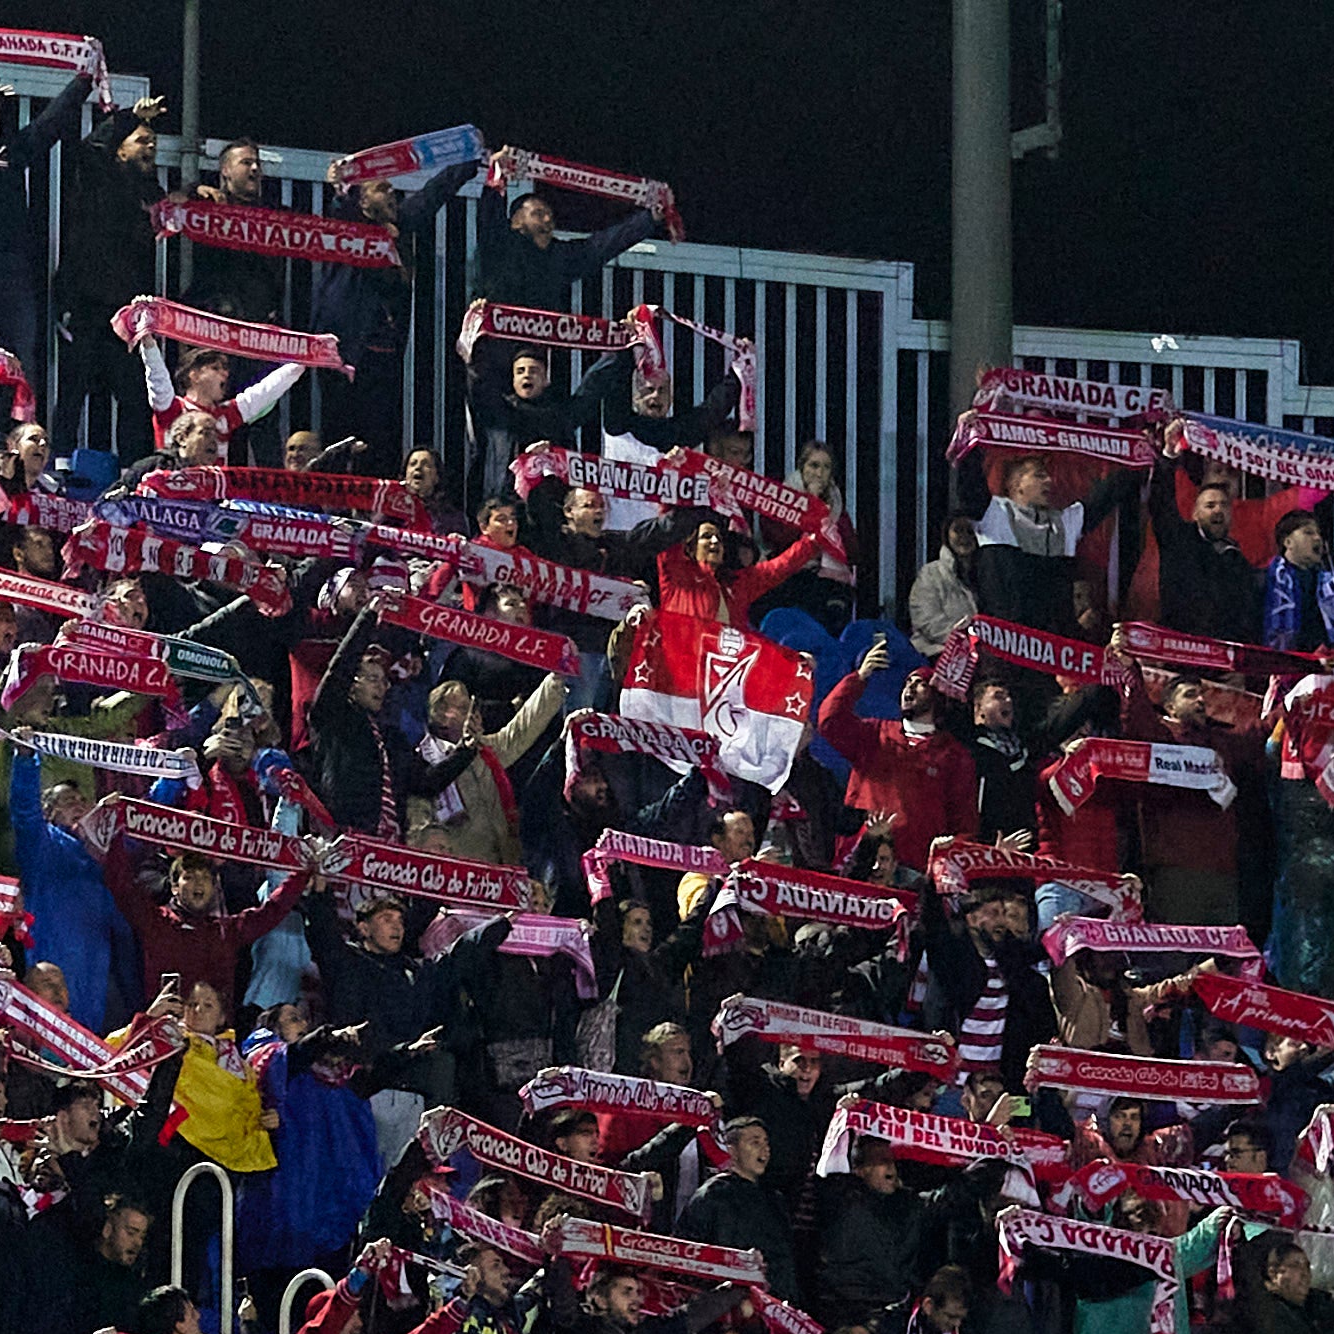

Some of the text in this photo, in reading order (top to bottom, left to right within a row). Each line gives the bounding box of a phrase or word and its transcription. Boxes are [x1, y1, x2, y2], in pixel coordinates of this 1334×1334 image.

[185, 208, 322, 253] GRANADA
[493, 311, 605, 342] Granada Club de
[1003, 373, 1119, 409] GRANADA
[569, 452, 672, 493] GRANADA
[1223, 442, 1302, 479] YO SOY DEL
[703, 457, 810, 525] GRANADA DE FÚTBOL
[251, 520, 329, 547] GRANADA
[376, 525, 459, 555] GRANADA
[495, 563, 585, 606] GRANADA
[418, 605, 513, 648] GRANADA
[48, 648, 143, 682] GRANADA
[972, 621, 1097, 675] GRANADA C.F.
[1155, 756, 1180, 772] Real
[125, 806, 237, 848] Granada Club de
[362, 854, 503, 898] Granada Club de Fútbol
[1236, 1002, 1327, 1033] primera!
[850, 1112, 1009, 1157] AL FIN DEL MUNDO
[465, 1124, 609, 1196] Granada Club de Fútbol
